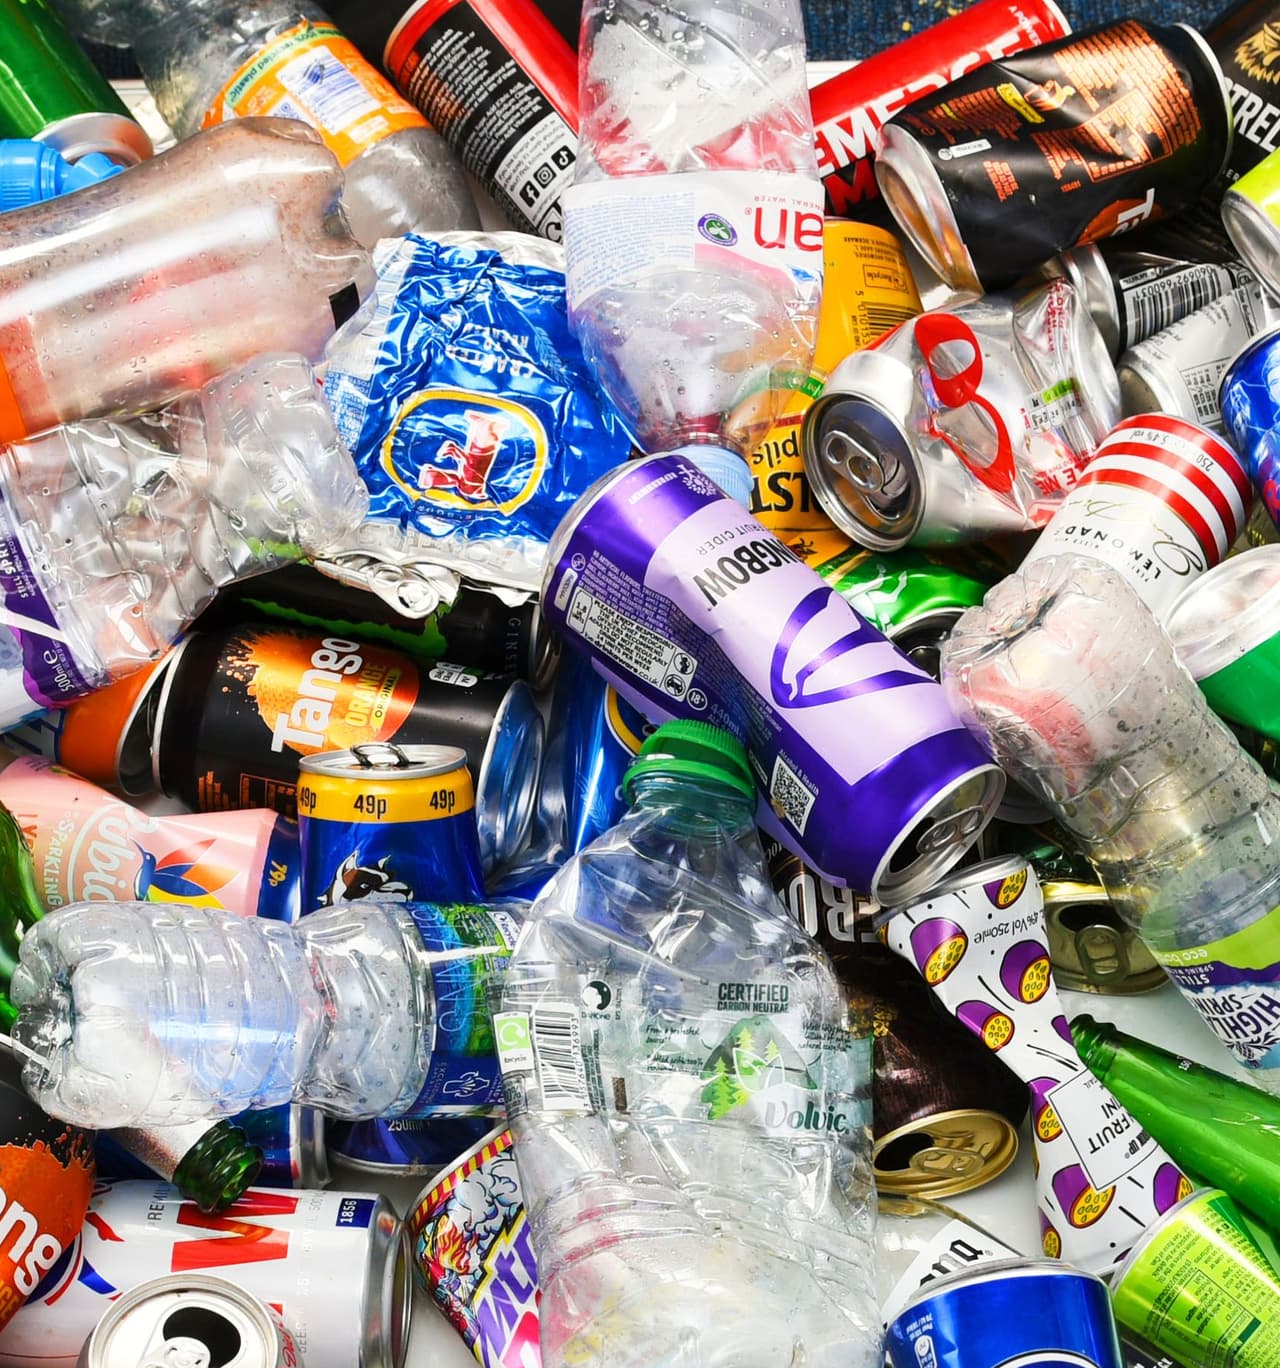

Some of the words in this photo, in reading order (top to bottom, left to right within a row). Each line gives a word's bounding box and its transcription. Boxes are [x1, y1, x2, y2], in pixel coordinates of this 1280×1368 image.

[271, 637, 365, 754] Tango
[345, 660, 388, 730] ORANGE
[353, 793, 388, 818] 49p
[429, 788, 457, 812] 49p
[717, 981, 790, 1003] CERTIFIED
